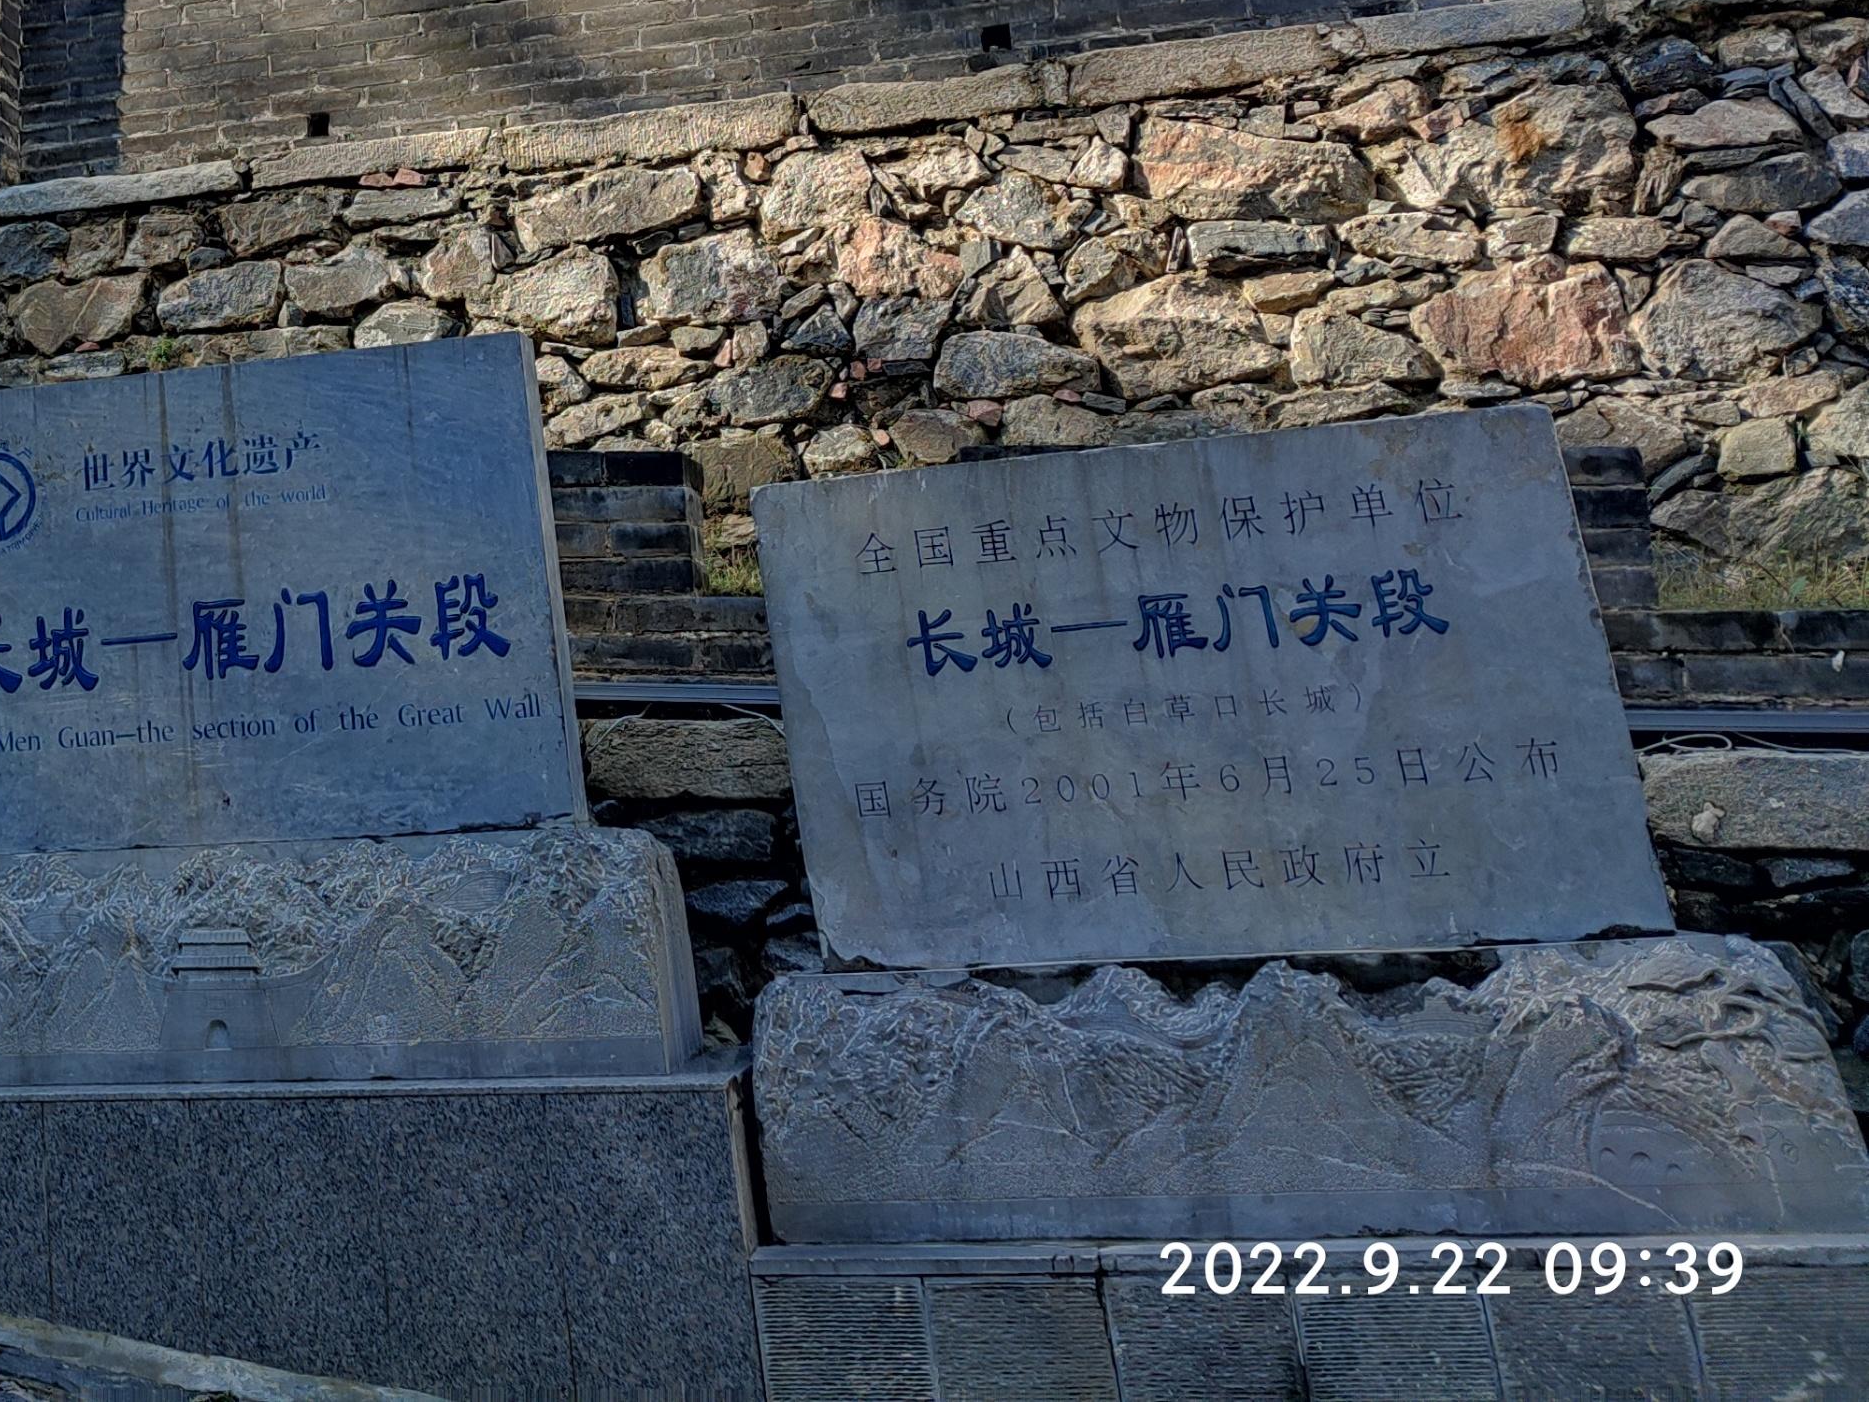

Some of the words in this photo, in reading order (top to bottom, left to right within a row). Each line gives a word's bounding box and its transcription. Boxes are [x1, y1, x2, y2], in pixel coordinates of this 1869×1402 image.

[83, 432, 321, 492] 世界文化遗产
[75, 504, 131, 524] Cultural
[141, 495, 206, 518] Heritage
[216, 494, 231, 510] of
[244, 490, 271, 508] the
[280, 483, 327, 505] world
[854, 476, 1464, 577] 全国重点文物保护单位
[192, 712, 276, 741] section
[294, 707, 320, 734] of
[339, 706, 379, 731] the
[398, 702, 466, 727] Great
[483, 691, 542, 720] Wall
[854, 737, 1561, 820] 国务院2001年6月25日公布
[988, 838, 1452, 902] 山西省人民政府立
